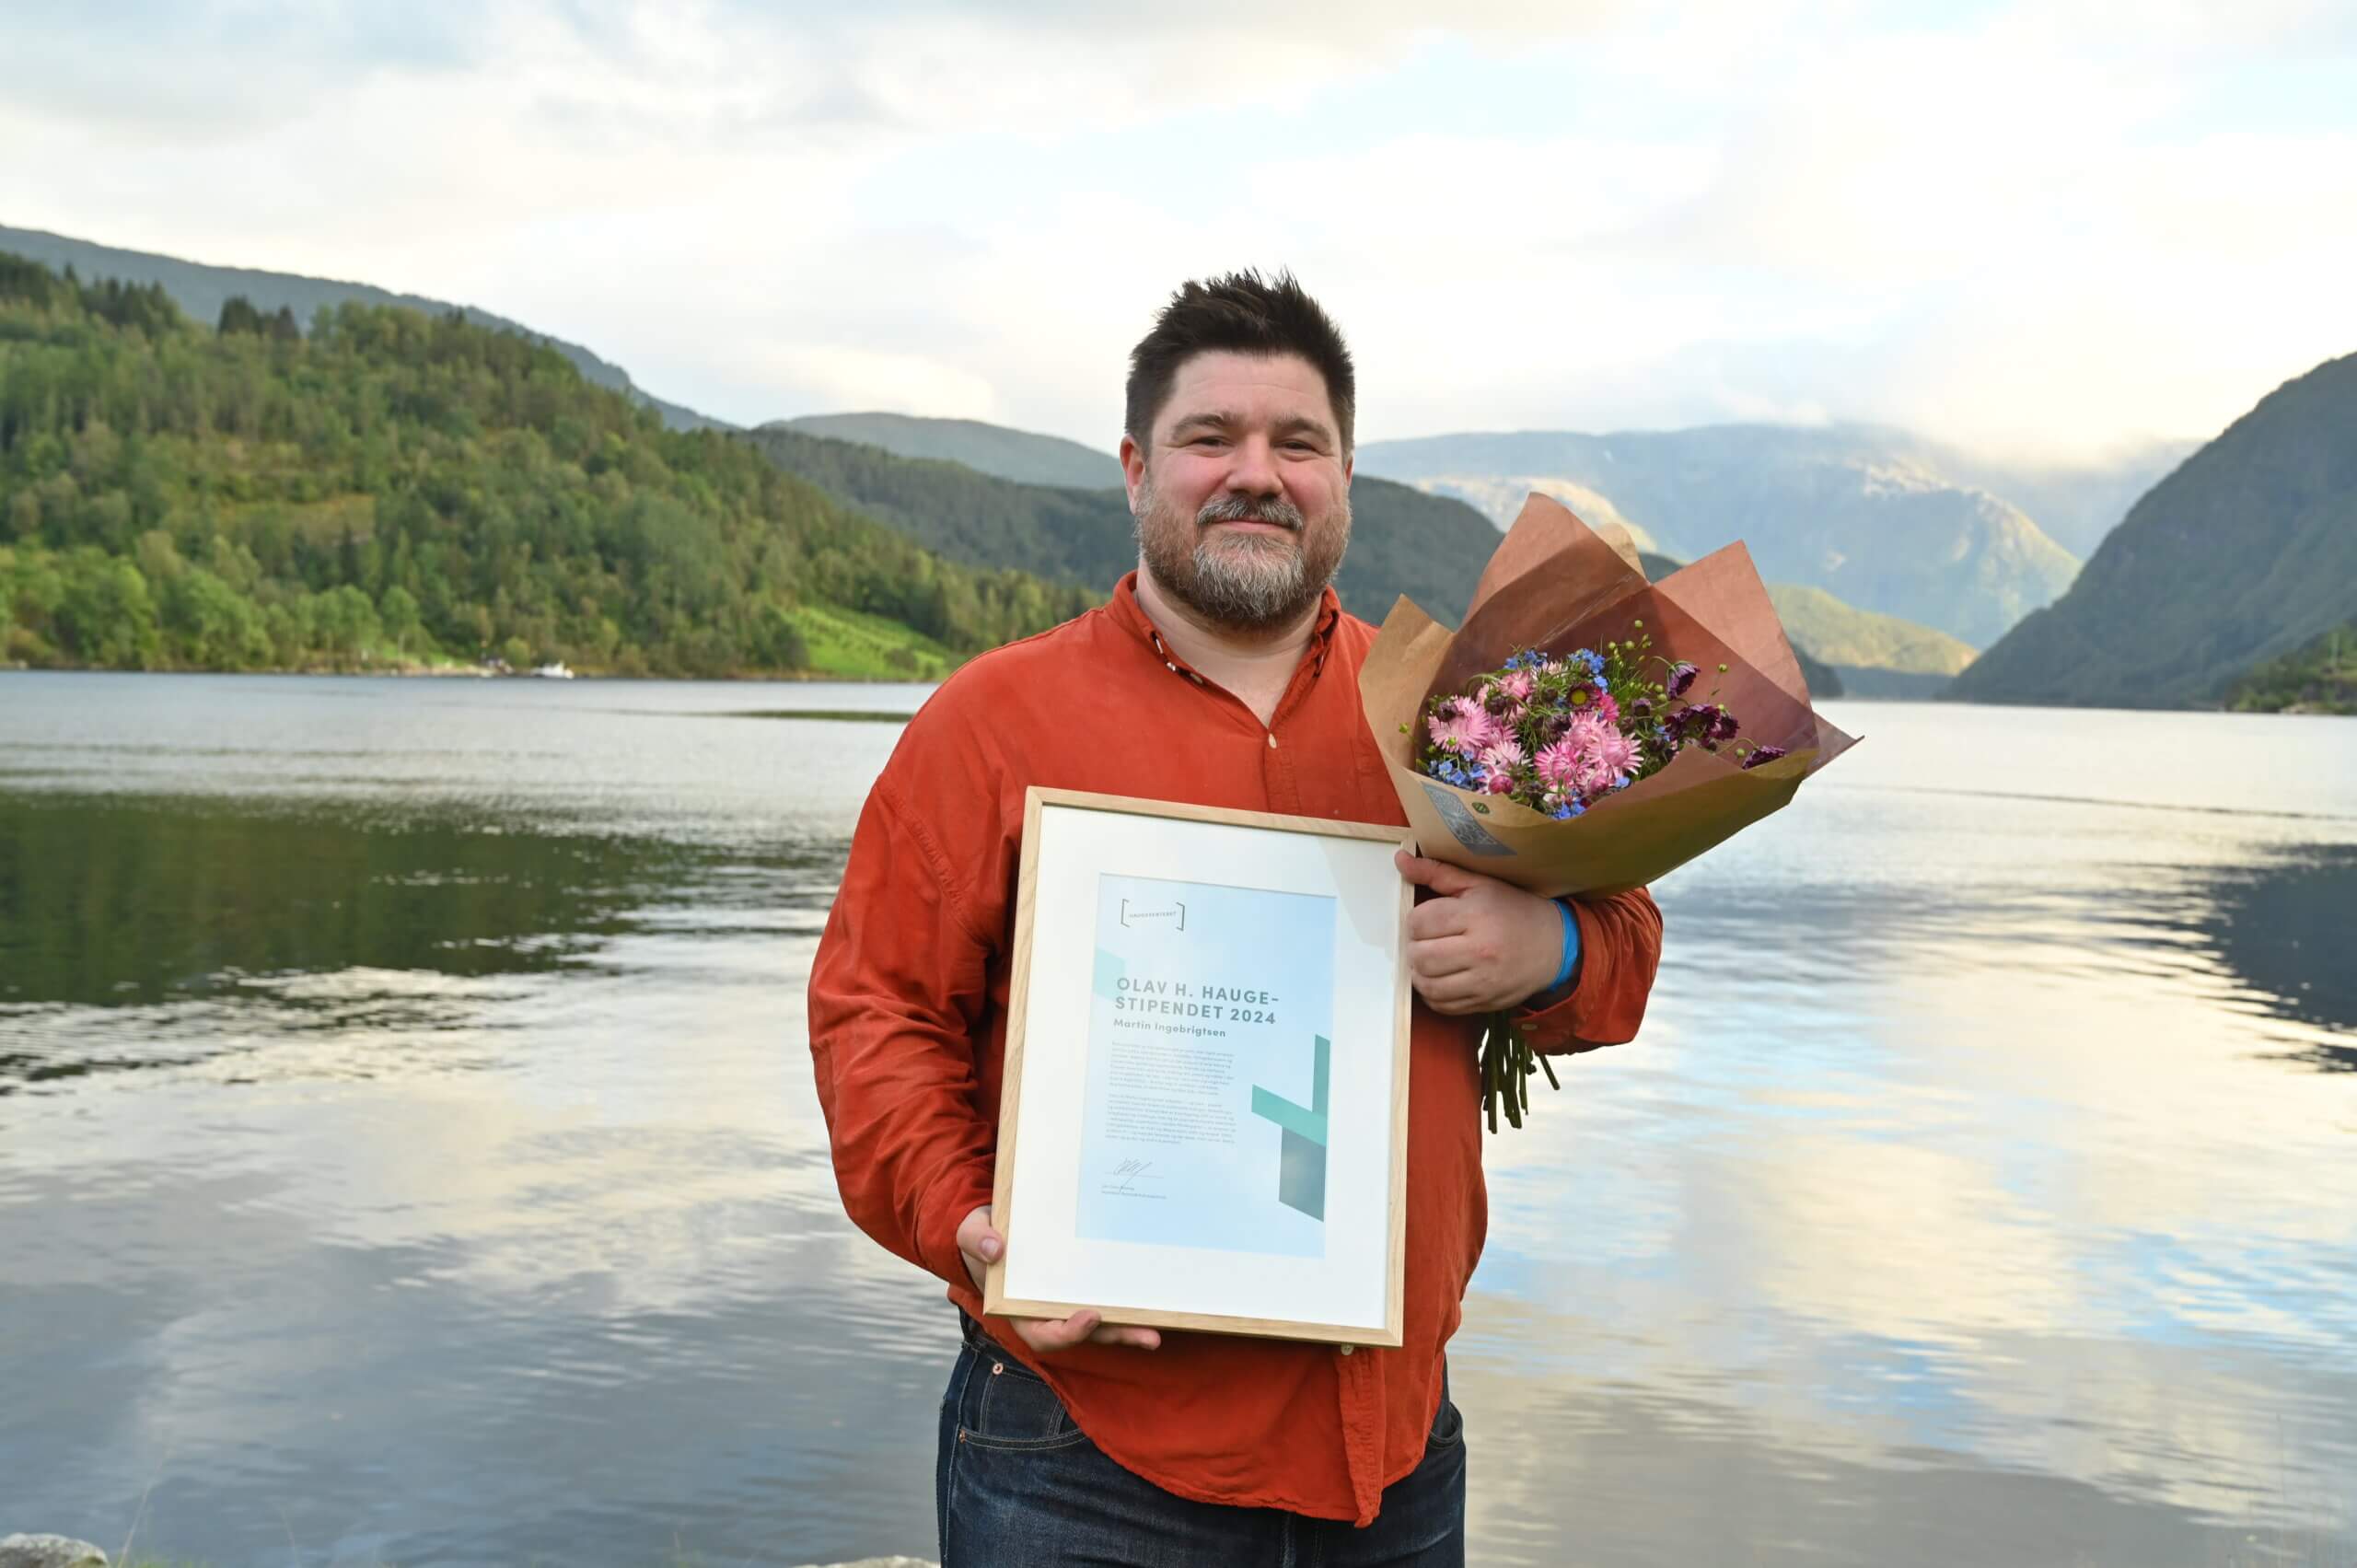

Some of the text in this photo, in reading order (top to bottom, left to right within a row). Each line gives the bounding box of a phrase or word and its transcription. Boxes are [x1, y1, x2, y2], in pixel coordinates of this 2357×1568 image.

[1116, 977, 1280, 1005] OLAV H. HAUGE-
[1114, 996, 1276, 1025] STIPENDET 2024
[1113, 1018, 1226, 1038] Martin Ingebrigtsen
